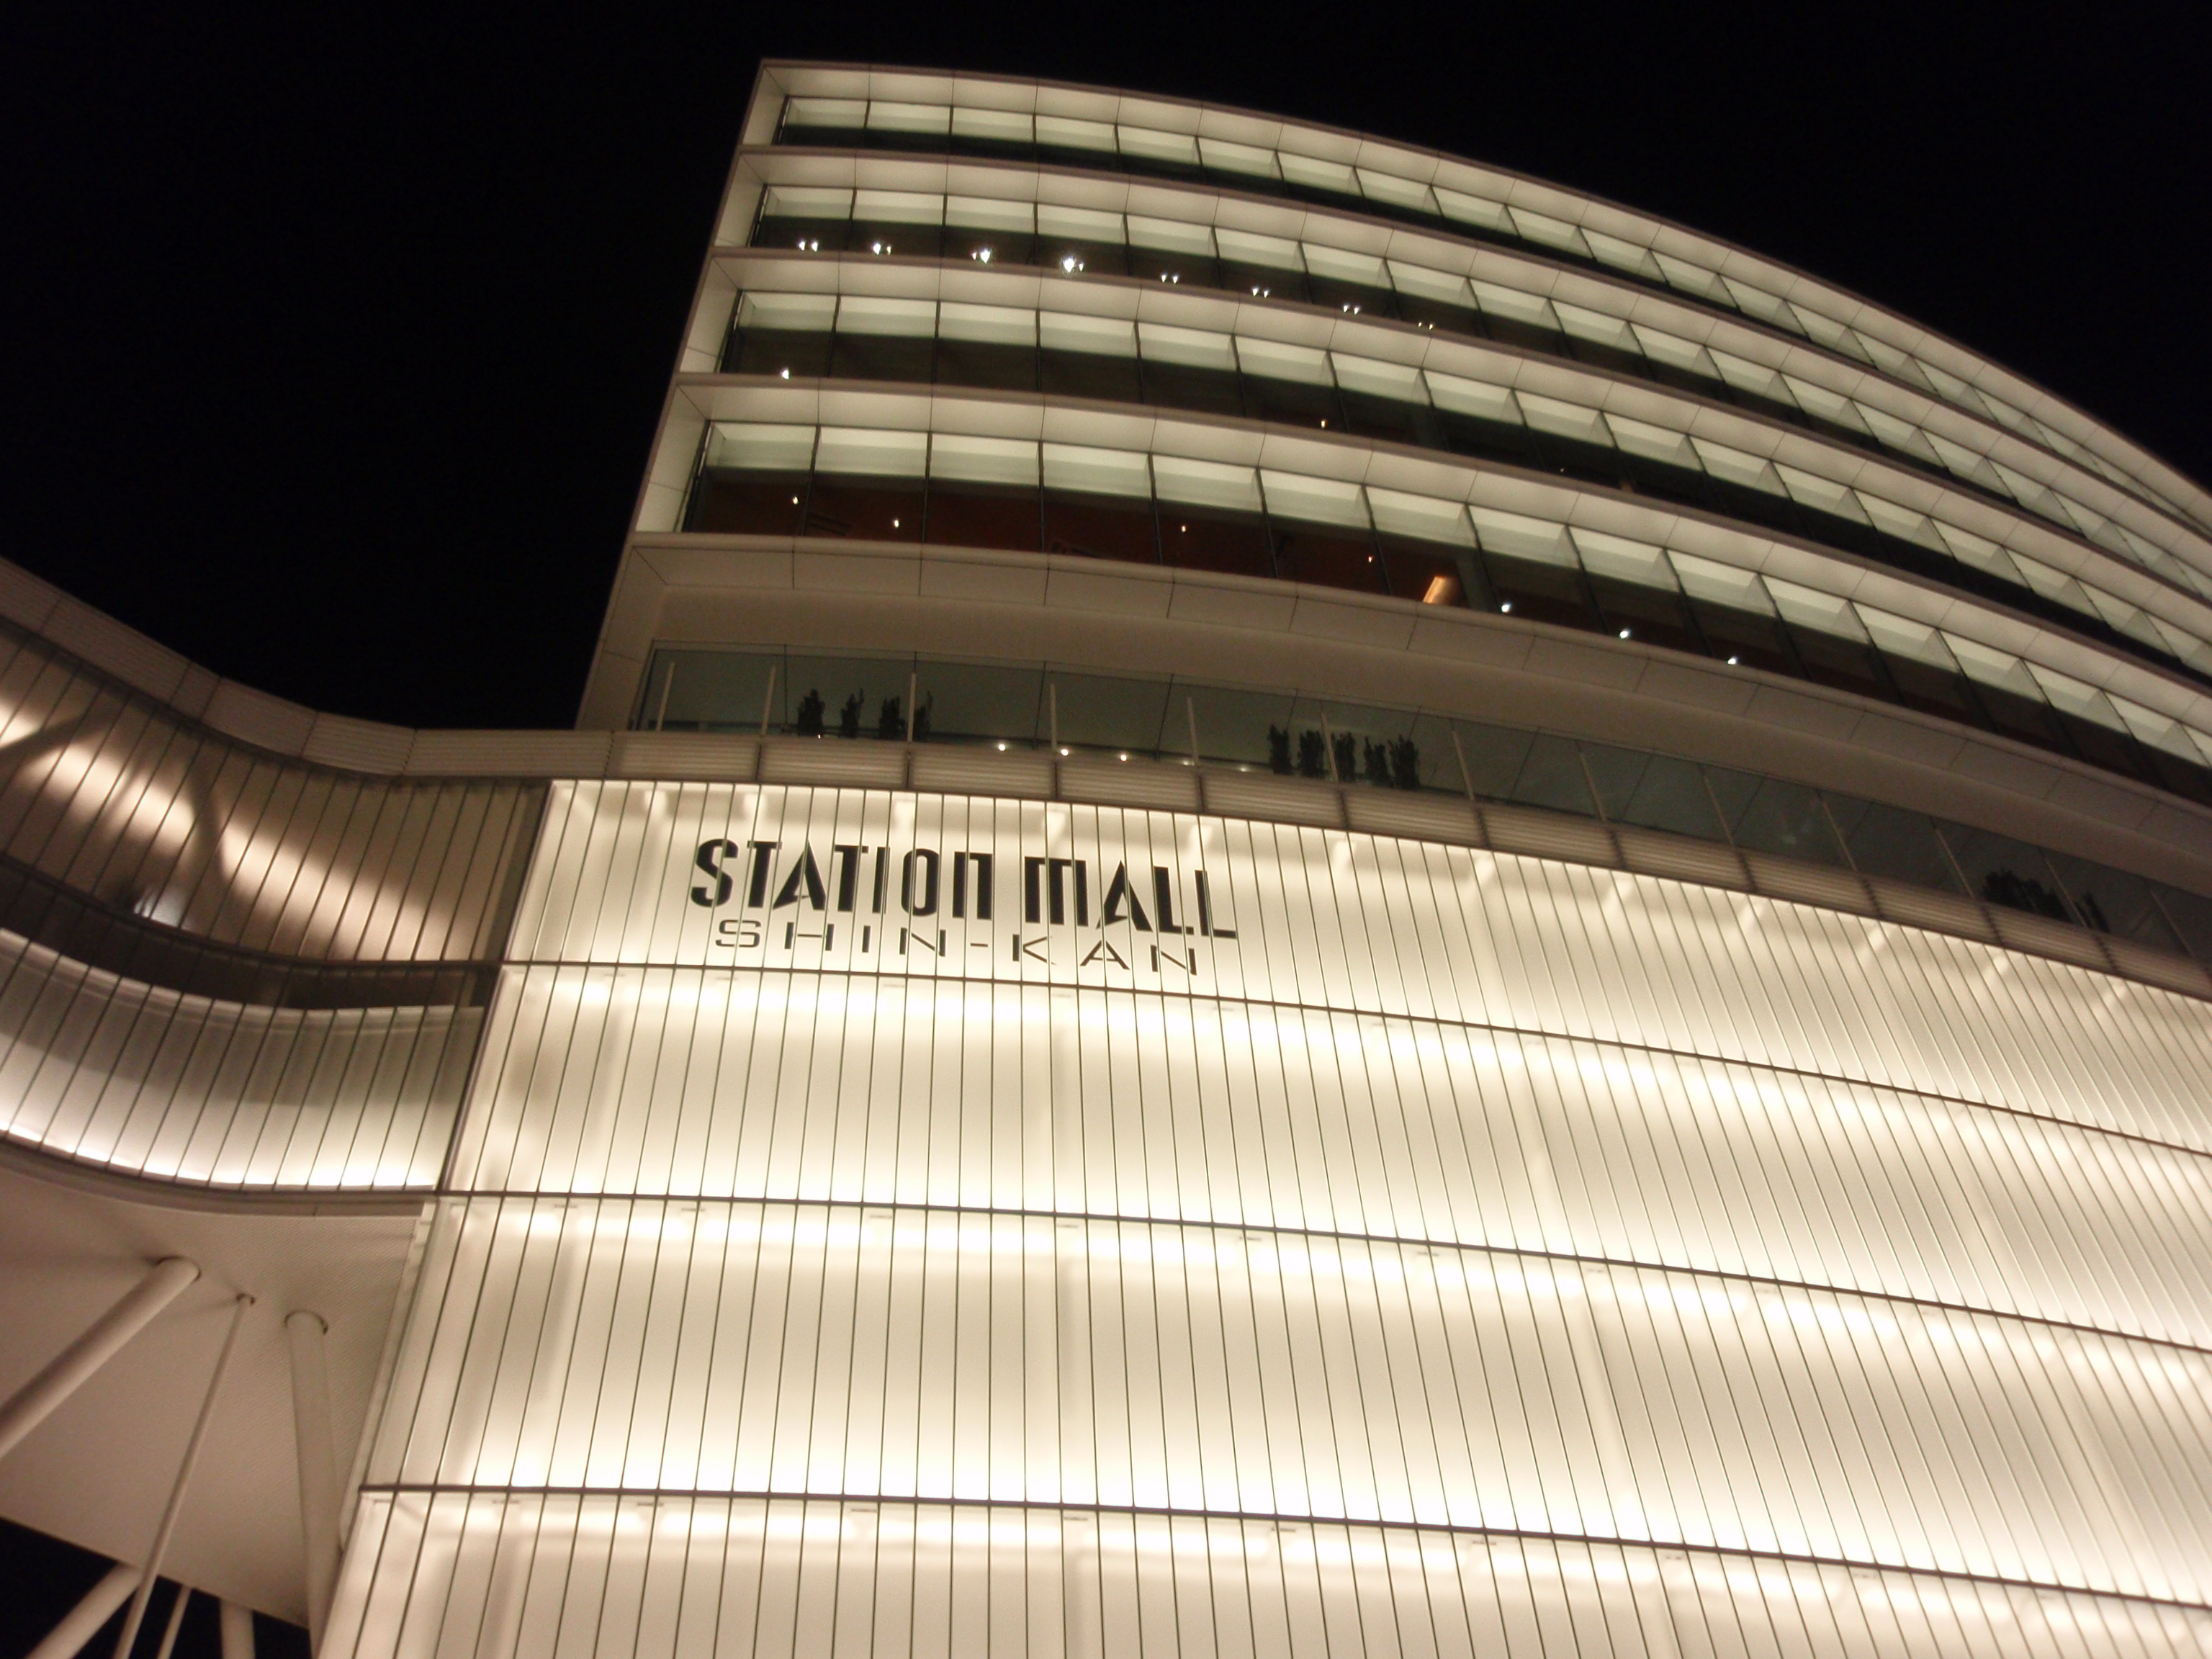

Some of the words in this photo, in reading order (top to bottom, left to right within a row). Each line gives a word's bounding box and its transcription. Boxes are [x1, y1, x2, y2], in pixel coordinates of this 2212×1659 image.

[690, 838, 993, 920] STATION
[1024, 855, 1238, 939] MALL
[714, 918, 1198, 976] SHIN-KAN
